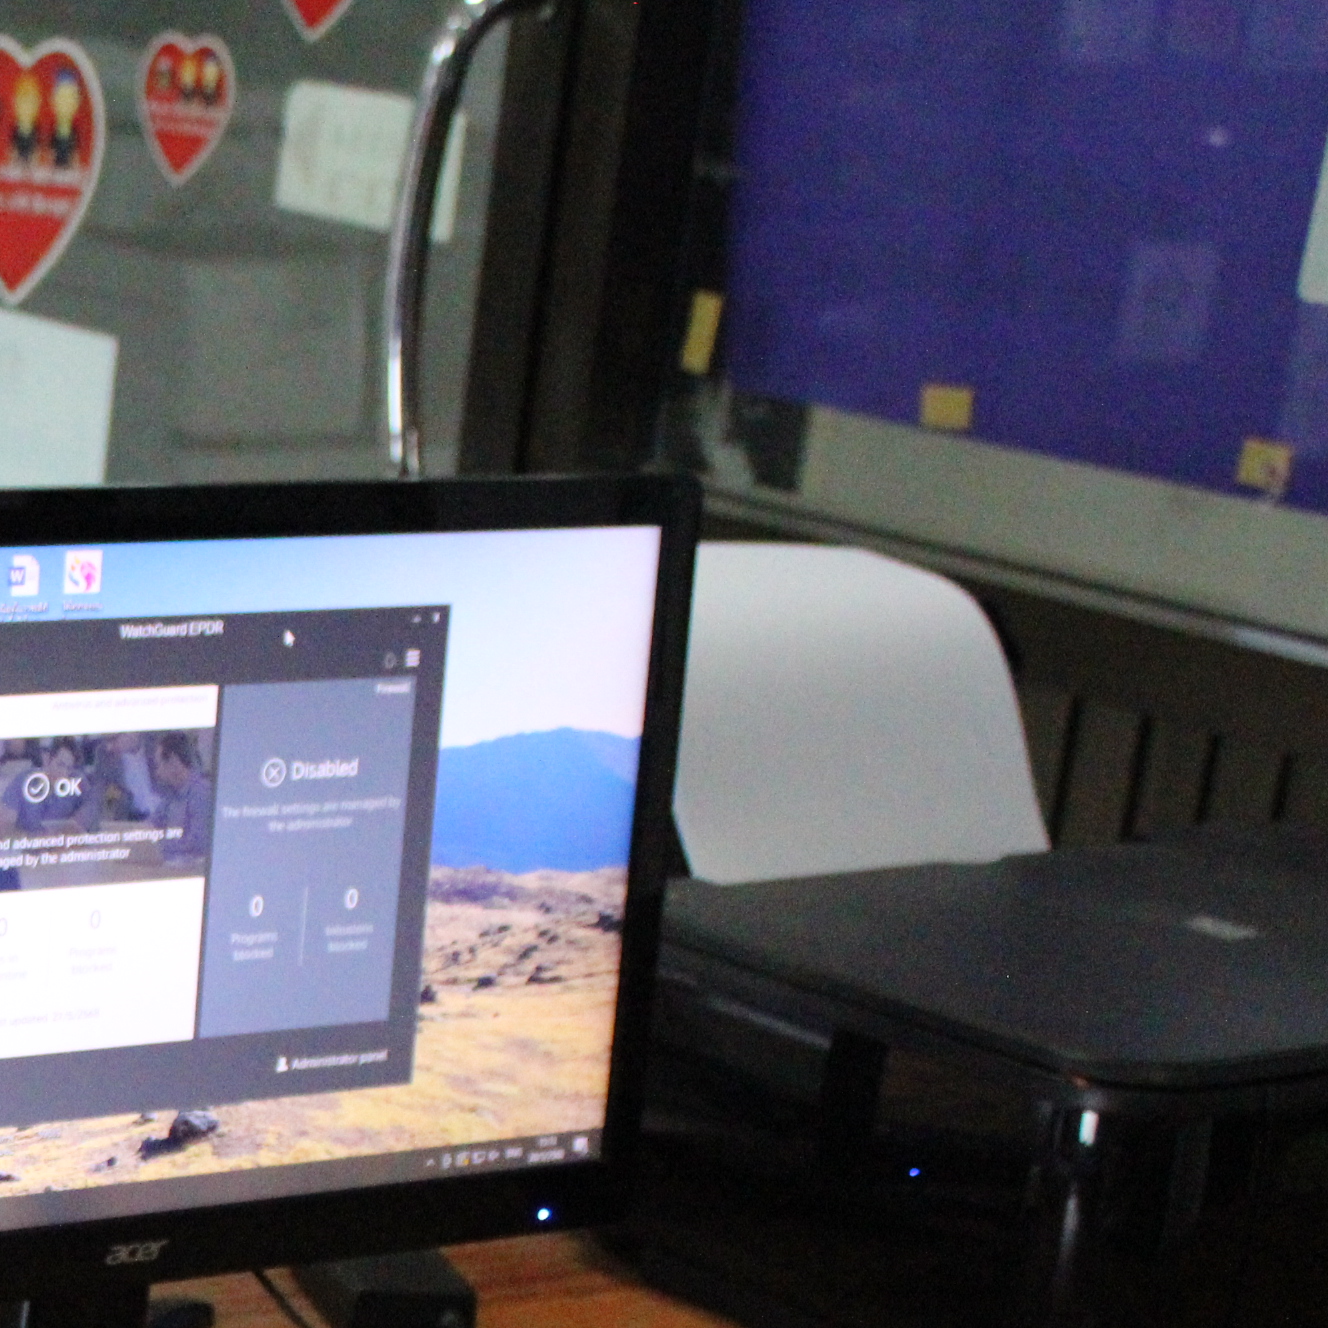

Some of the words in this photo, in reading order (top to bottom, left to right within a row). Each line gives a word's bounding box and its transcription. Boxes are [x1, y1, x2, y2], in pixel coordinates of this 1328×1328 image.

[291, 757, 360, 781] Disabled
[55, 777, 82, 797] OK
[13, 834, 64, 850] advanced
[67, 830, 121, 848] protection
[123, 827, 165, 844] settings
[25, 853, 39, 868] by
[41, 852, 58, 865] the
[251, 895, 264, 917] 0
[346, 887, 359, 910] 0
[104, 1239, 170, 1266] acer
